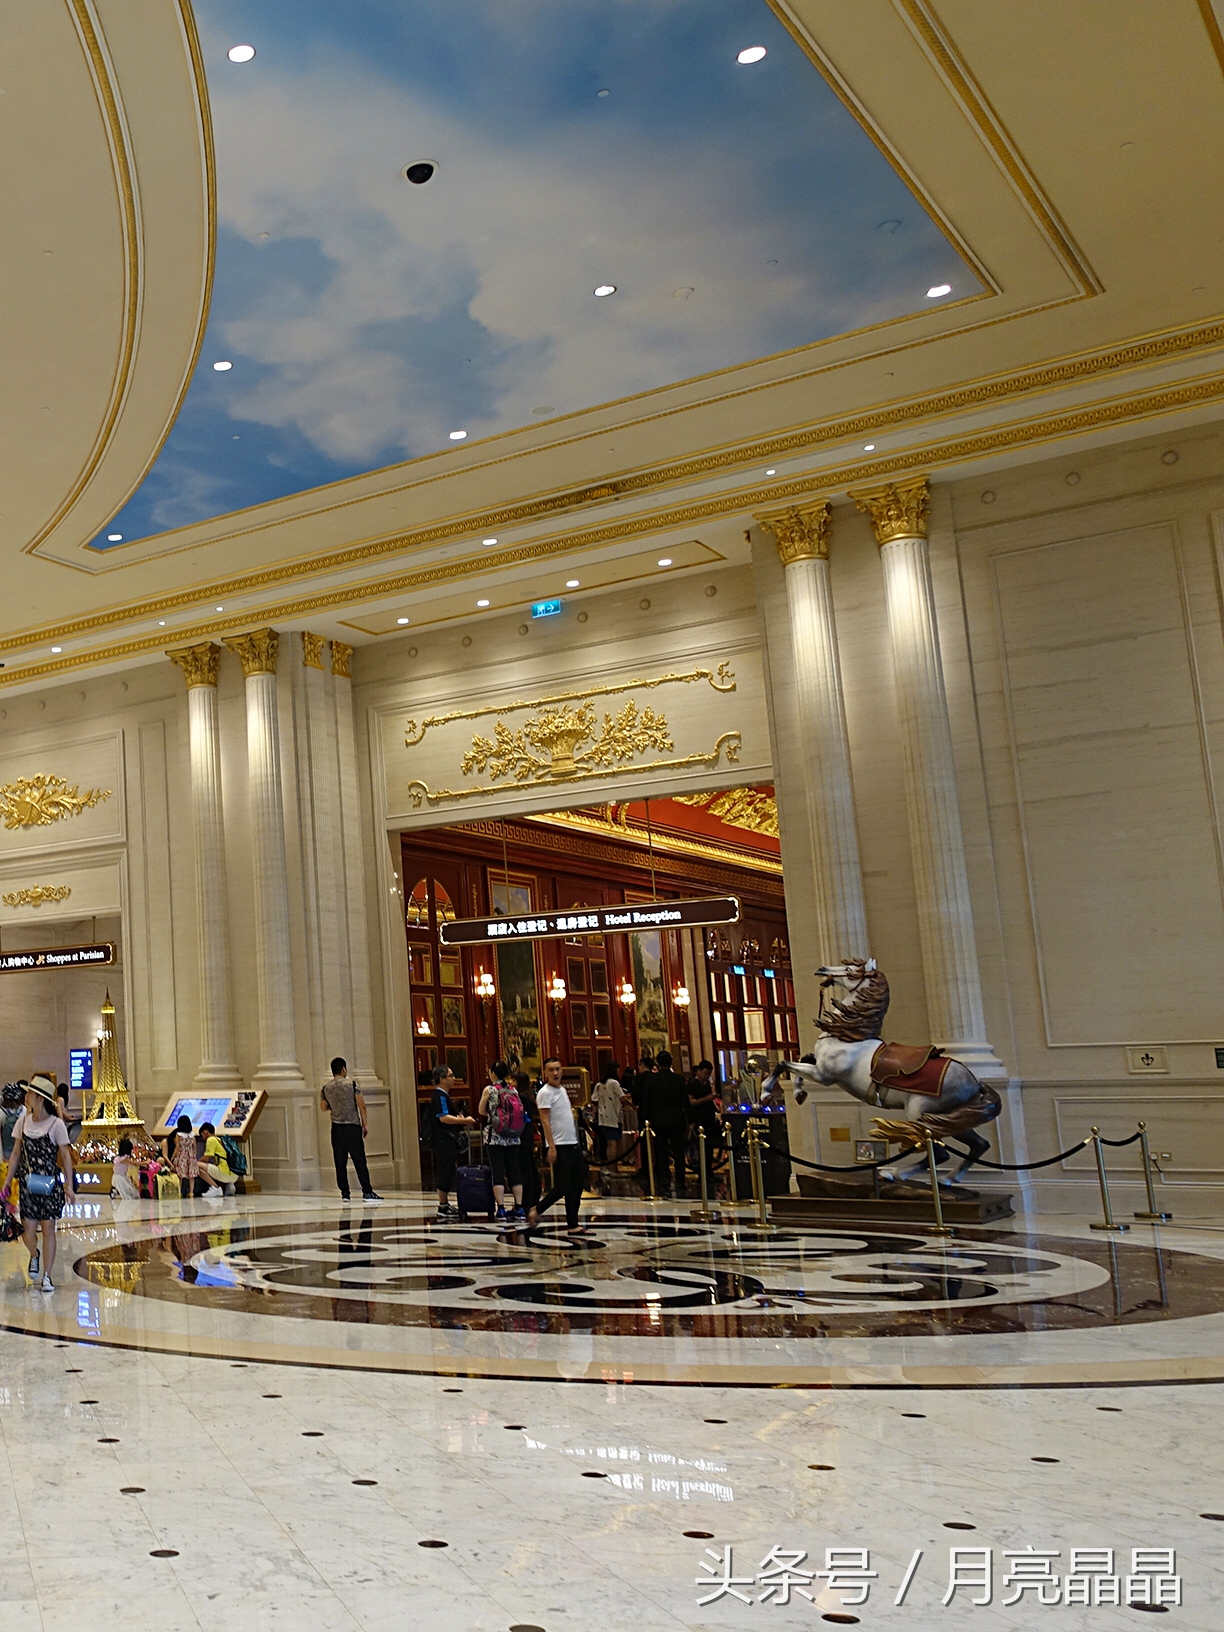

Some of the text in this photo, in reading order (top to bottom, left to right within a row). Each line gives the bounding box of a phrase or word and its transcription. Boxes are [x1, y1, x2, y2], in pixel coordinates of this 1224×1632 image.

[604, 910, 682, 926] Hotel Reception
[46, 950, 105, 965] Shoppes at Parisian
